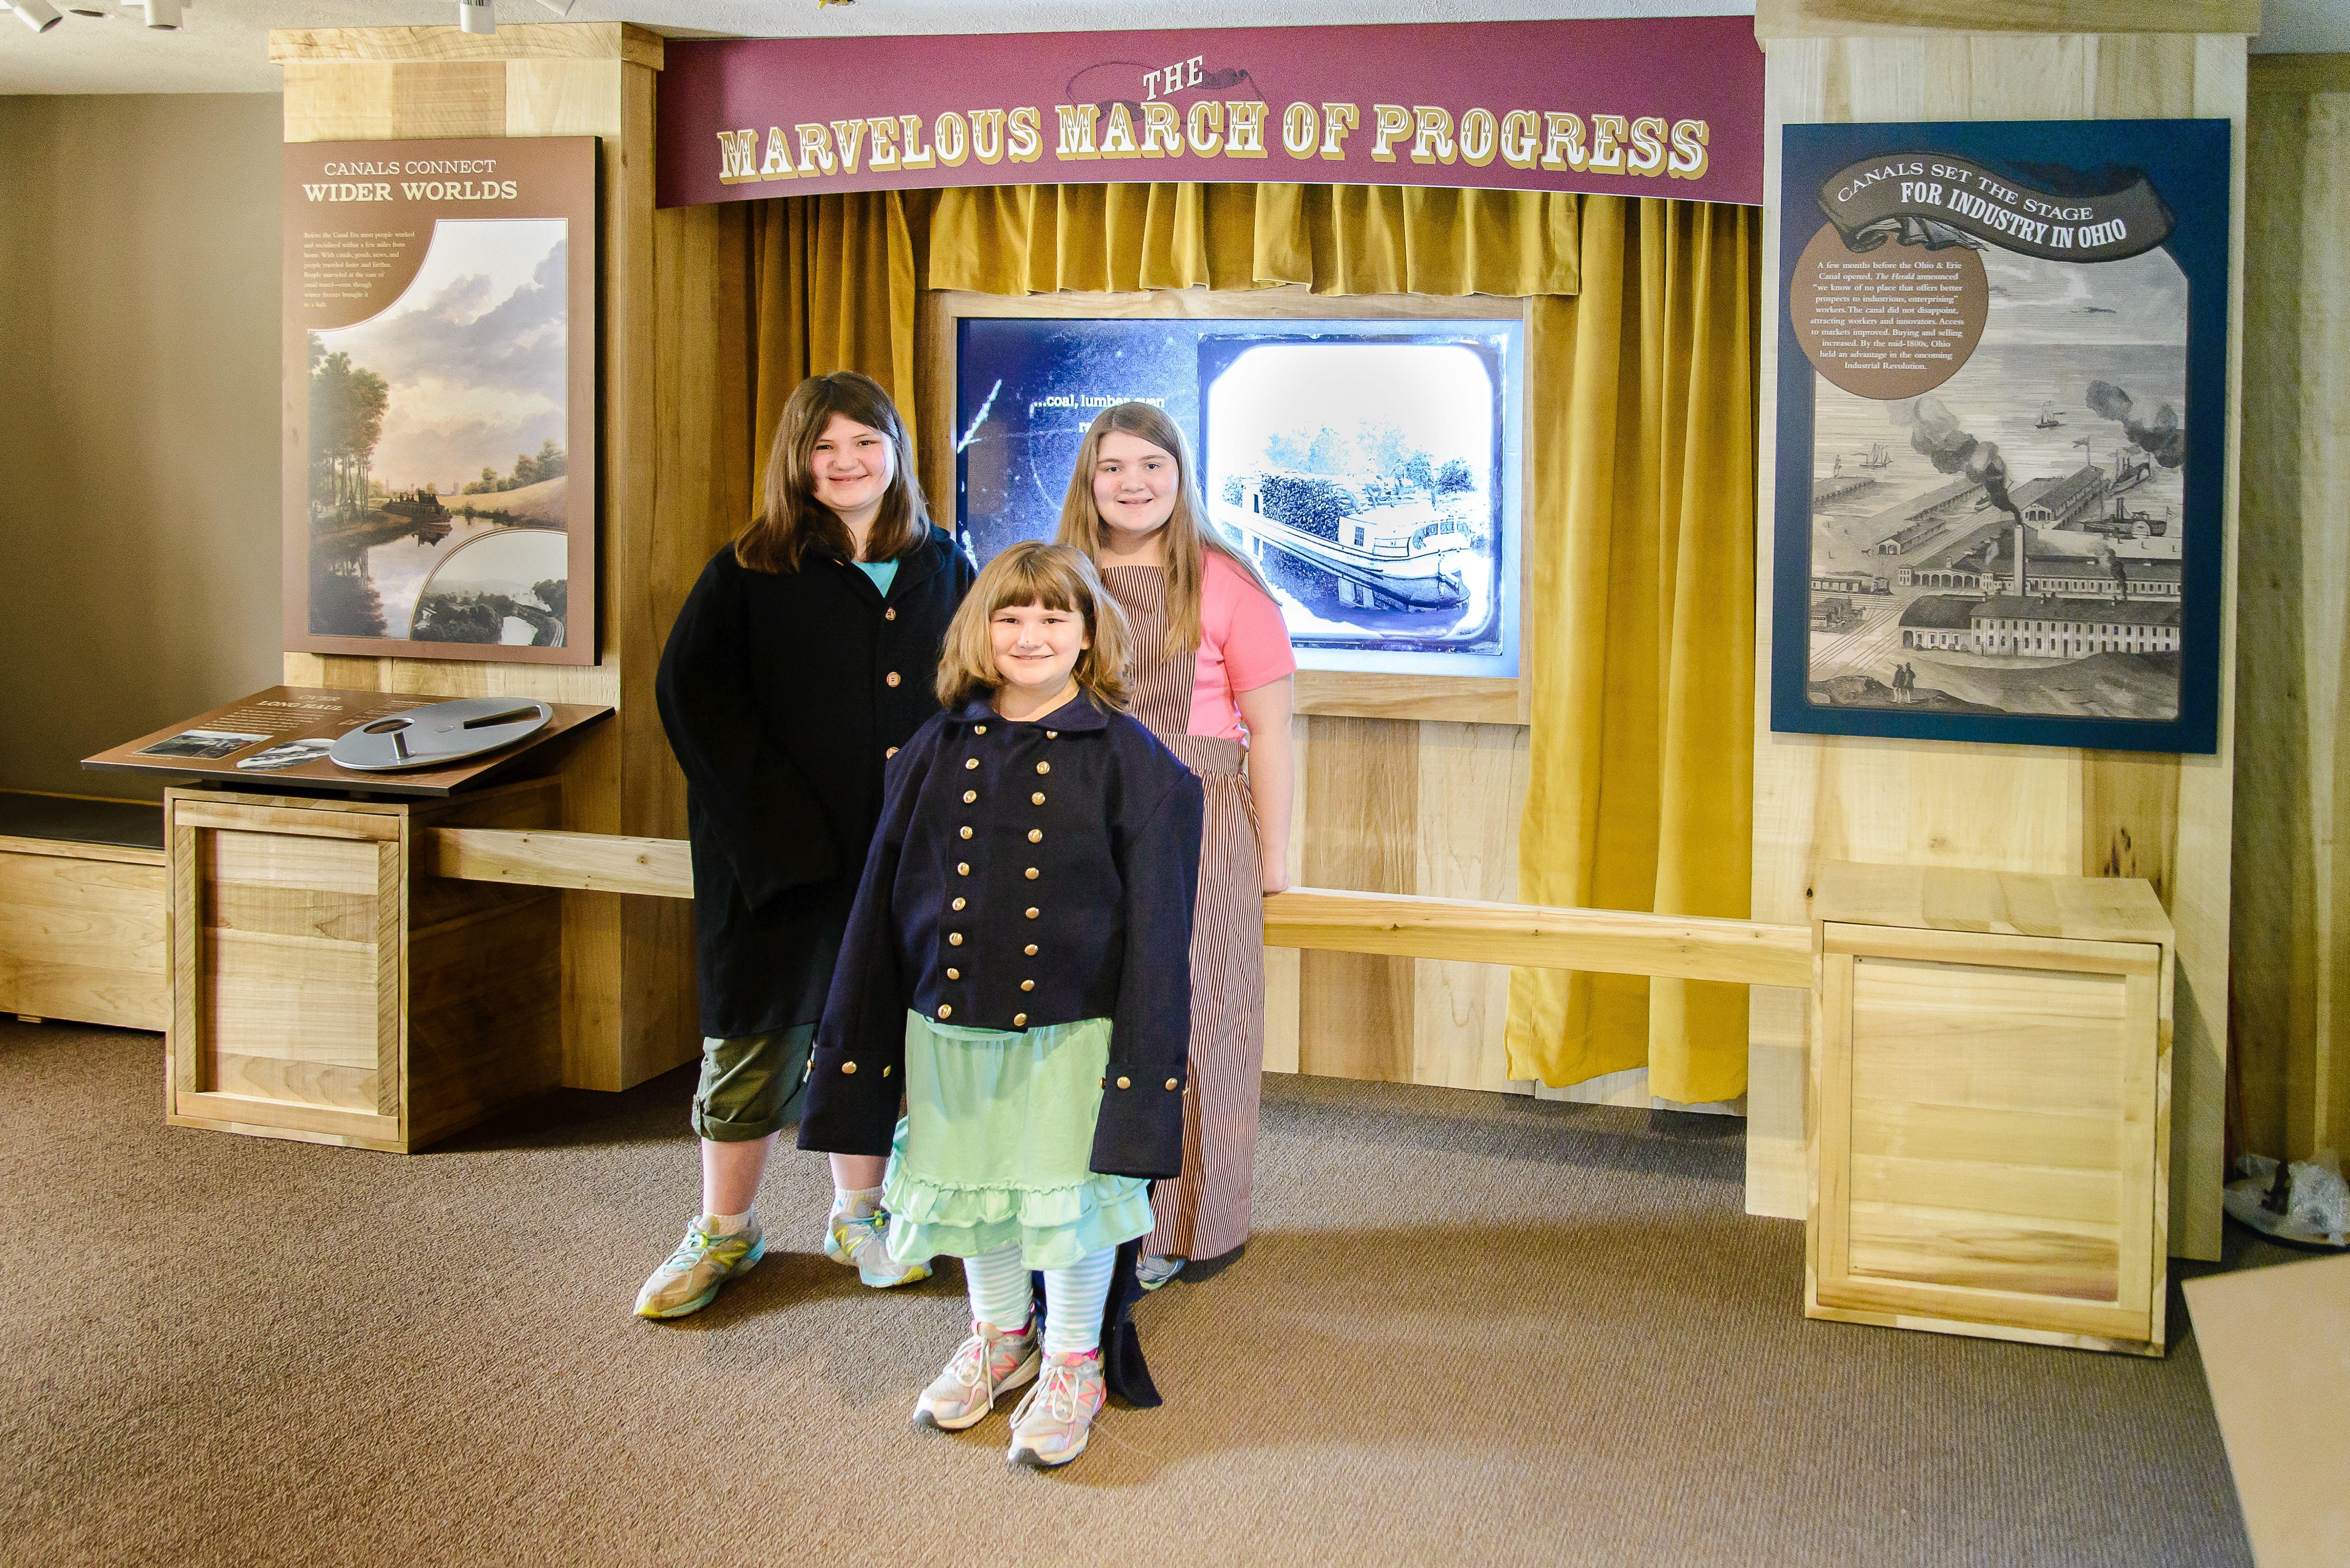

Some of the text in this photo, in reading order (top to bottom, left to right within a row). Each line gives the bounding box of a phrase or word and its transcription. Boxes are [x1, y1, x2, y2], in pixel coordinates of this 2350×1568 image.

[1142, 54, 1204, 101] THE
[716, 101, 1709, 185] MARVELOUS MARCH OF PROGRESS
[325, 160, 497, 176] CANALS CONNECT
[302, 181, 518, 202] WIDER WORLDS
[1838, 163, 2093, 220] CANALS SET THE STAGE
[1901, 182, 2127, 248] FOR INDUSTRY IN OHIO
[1843, 274, 1873, 282] opened,
[1877, 284, 1896, 293] place
[1917, 307, 1958, 315] disappoint,
[1810, 318, 1845, 326] attracting
[1853, 328, 1889, 337] improved.
[1892, 329, 1919, 337] Buying
[1939, 329, 1963, 337] selling
[1861, 340, 1870, 348] By
[1850, 351, 1887, 359] advantage
[301, 703, 343, 711] HAUL
